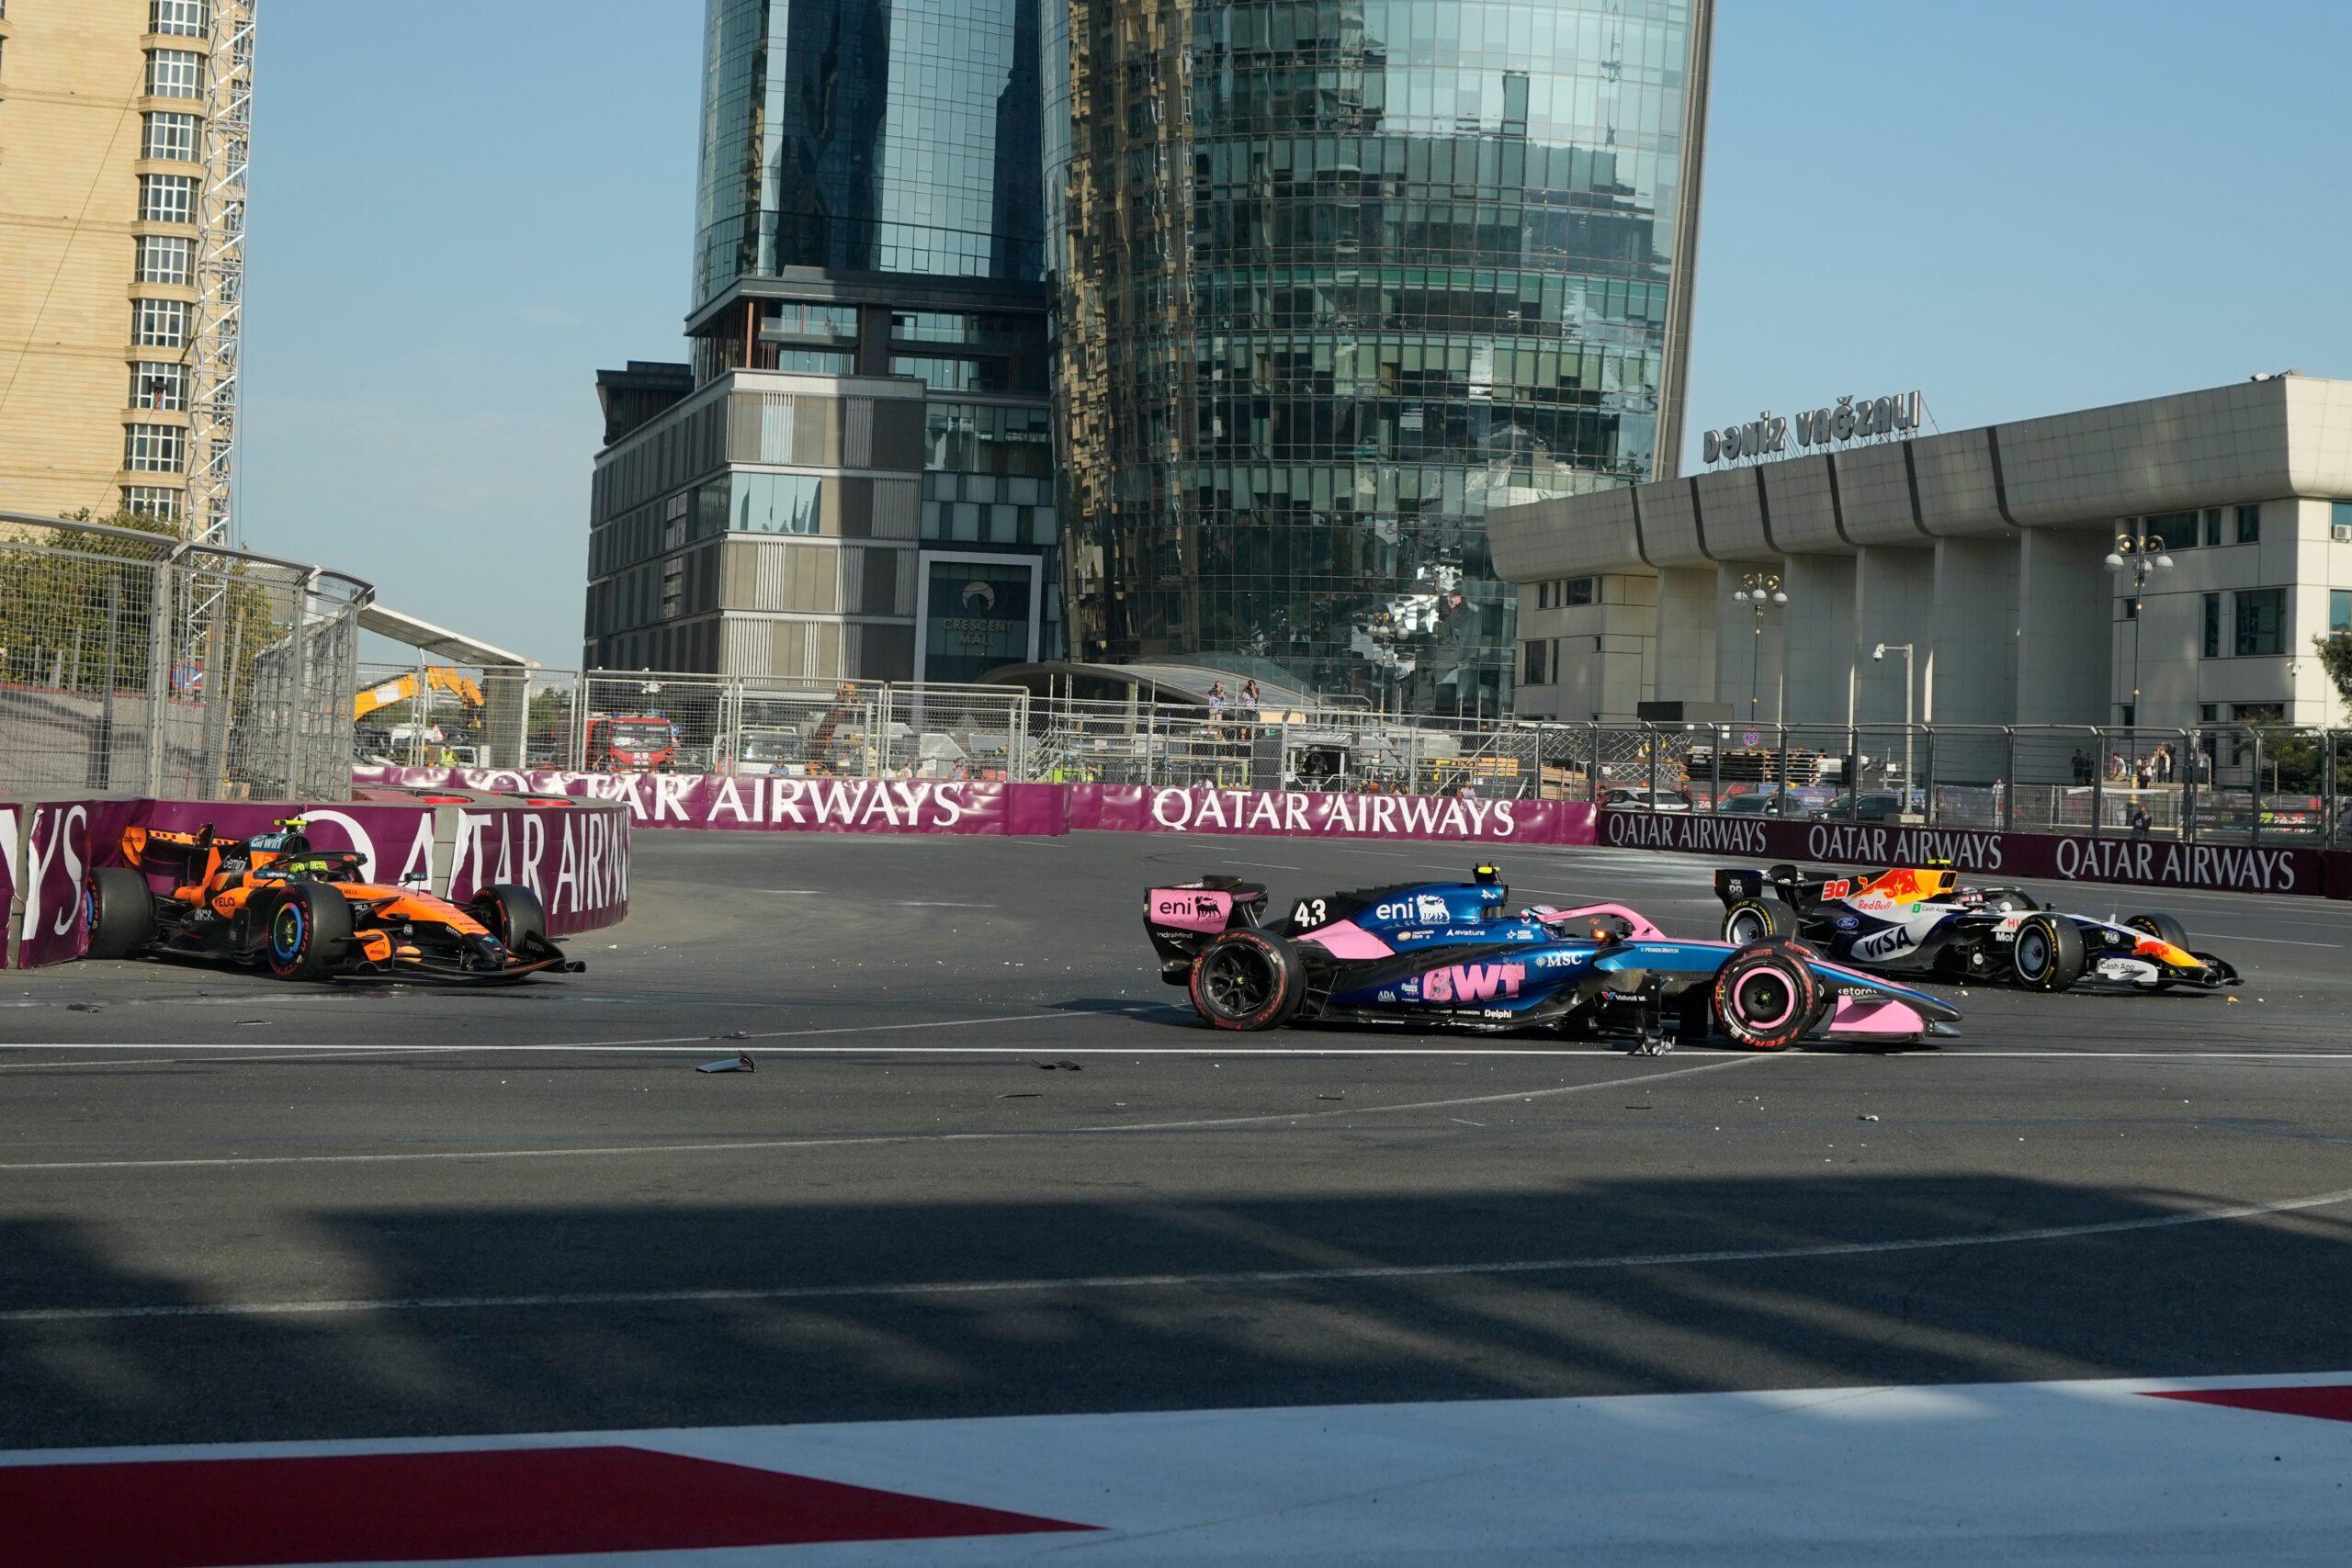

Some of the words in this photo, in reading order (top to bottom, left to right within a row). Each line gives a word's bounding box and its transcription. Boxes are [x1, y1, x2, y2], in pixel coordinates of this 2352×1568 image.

[1702, 411, 1786, 463] DƏNİZ
[1795, 389, 1920, 446] VAĞZALI
[943, 618, 1013, 632] CRESCENT
[959, 634, 994, 646] MALL
[707, 776, 961, 827] AIRWAYS
[1153, 788, 1312, 831] QATAR
[1324, 794, 1515, 837] AIRWAYS
[1609, 813, 1674, 846] QATAR
[1679, 818, 1767, 852] AIRWAYS
[1809, 825, 1888, 862] QATAR
[1894, 829, 2002, 870] AIRWAYS
[223, 854, 248, 871] Gemini
[2056, 839, 2154, 880] QATAR
[2161, 844, 2295, 890] AIRWAYS
[1822, 879, 1849, 900] 30
[214, 897, 236, 908] VELO
[1159, 897, 1192, 915] eni
[1376, 898, 1414, 920] eni
[1858, 899, 1874, 909] Red
[1874, 900, 1893, 910] Bull
[1295, 899, 1326, 927] 43
[1840, 919, 1857, 929] Ford
[1863, 925, 1916, 958] VISA
[2106, 933, 2120, 942] FIA
[1547, 953, 1583, 967] MSC
[2121, 963, 2135, 971] App
[1423, 964, 1526, 1001] BWT
[1378, 990, 1396, 998] ADA
[1485, 1009, 1512, 1019] Delphi
